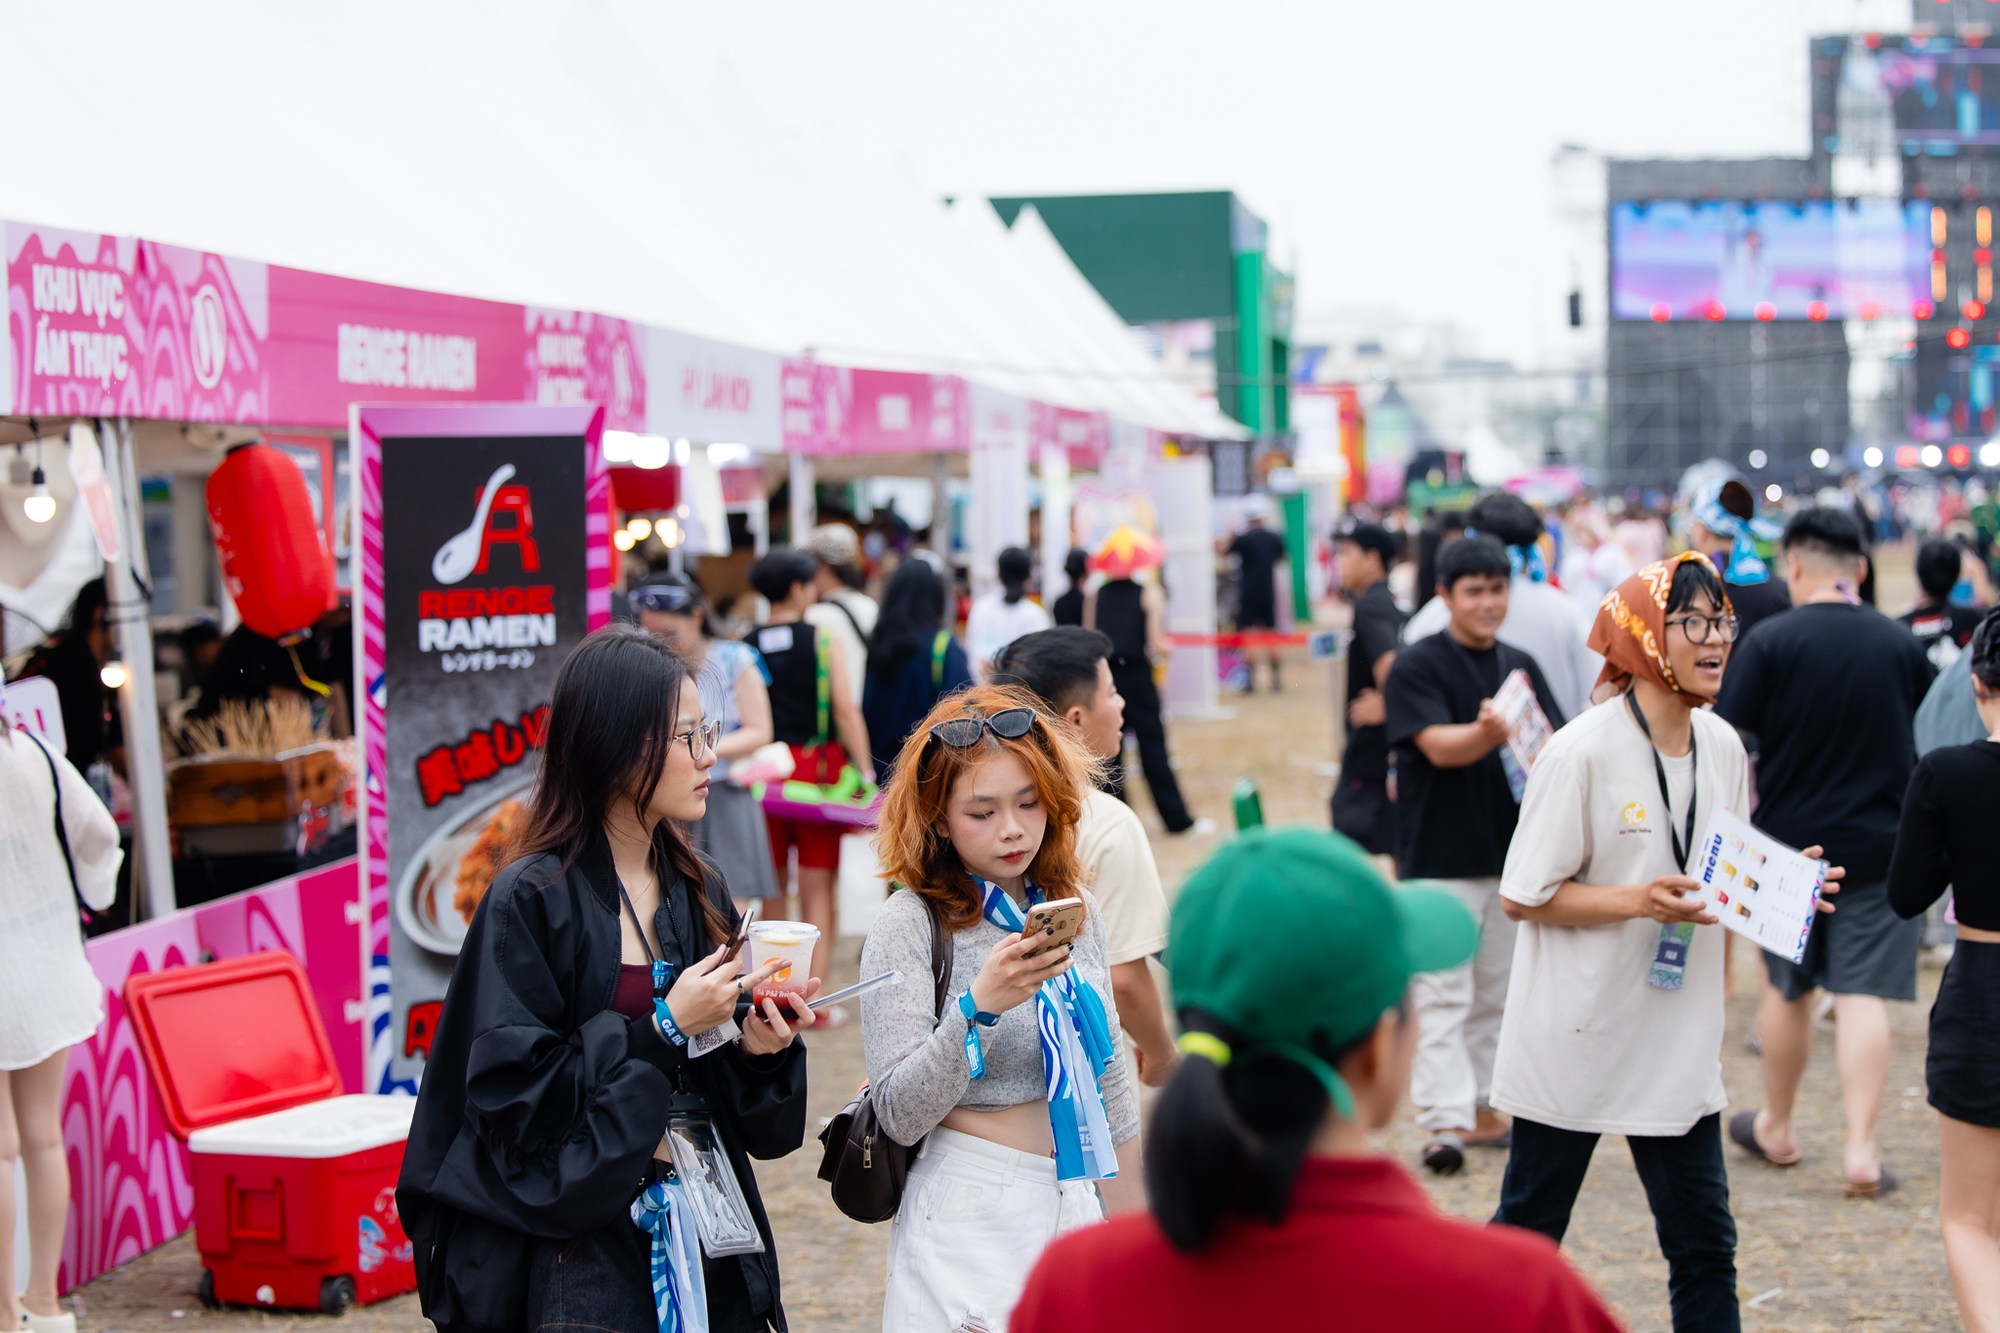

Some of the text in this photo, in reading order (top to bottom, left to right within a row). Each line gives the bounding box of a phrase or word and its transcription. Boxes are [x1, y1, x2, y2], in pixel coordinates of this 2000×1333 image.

[33, 262, 125, 329] KHU VỰC
[71, 330, 128, 391] THỰC
[338, 322, 406, 389] RENGE
[407, 330, 477, 393] RAMEN
[418, 584, 555, 619] RENGE
[418, 612, 557, 653] RAMEN
[1703, 833, 1723, 884] menu
[661, 1018, 676, 1038] GA
